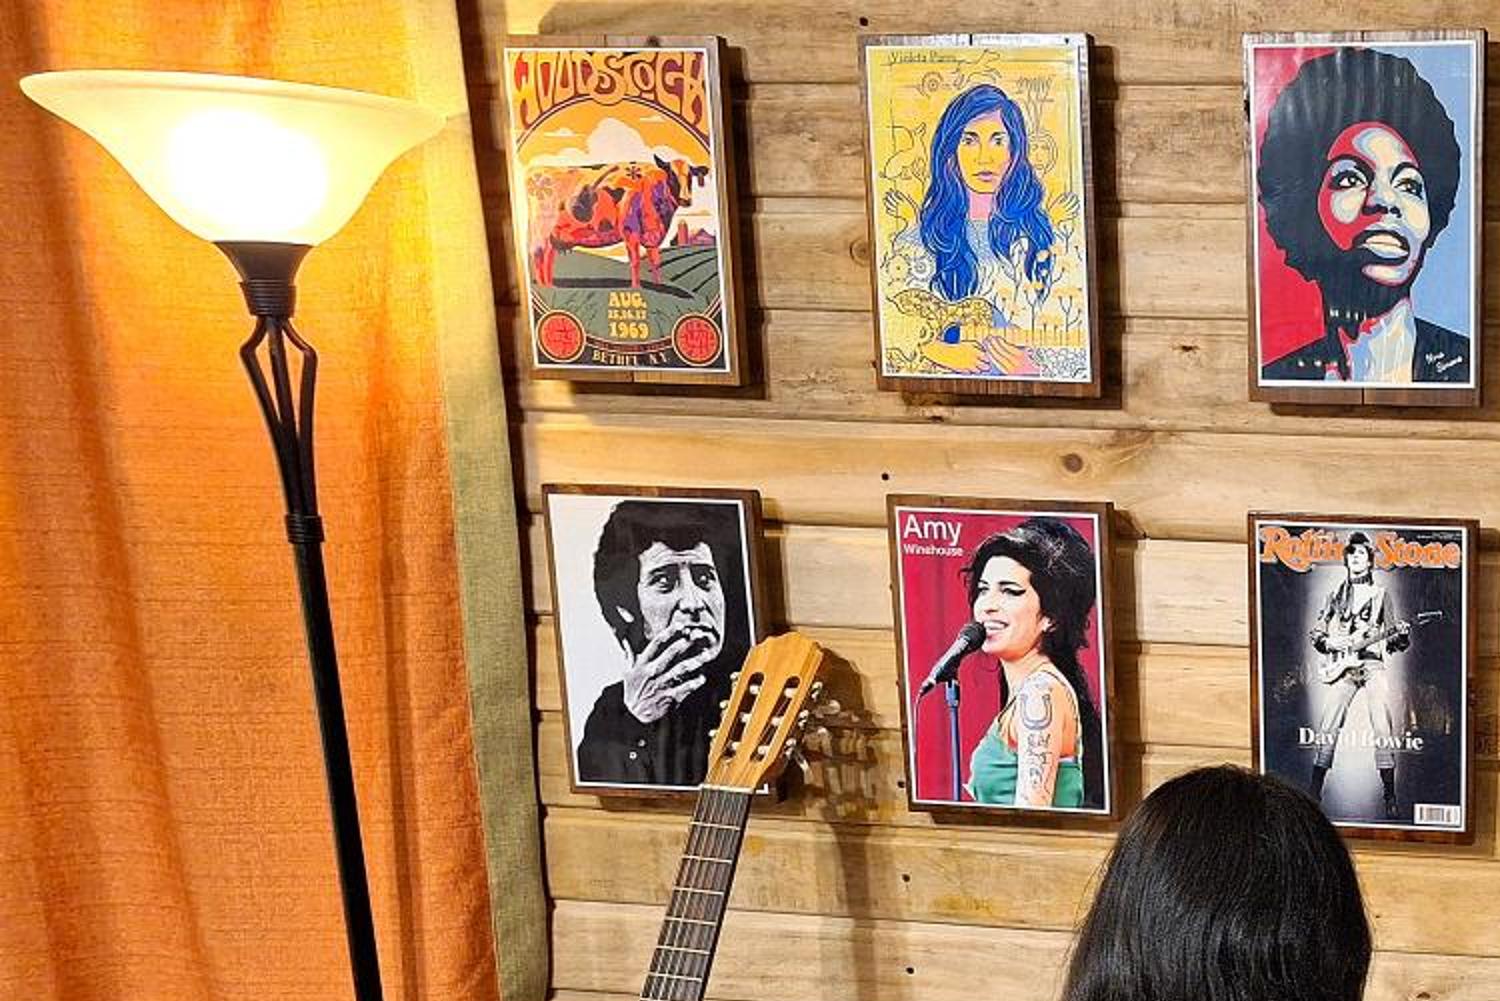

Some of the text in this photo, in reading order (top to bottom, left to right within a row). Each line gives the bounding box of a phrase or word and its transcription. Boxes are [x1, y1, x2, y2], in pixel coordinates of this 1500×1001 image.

[608, 291, 648, 309] AUG.
[609, 322, 649, 339] 1969
[903, 514, 962, 546] Amy
[1259, 526, 1461, 572] Rollin Stone
[1361, 730, 1424, 750] Bowie
